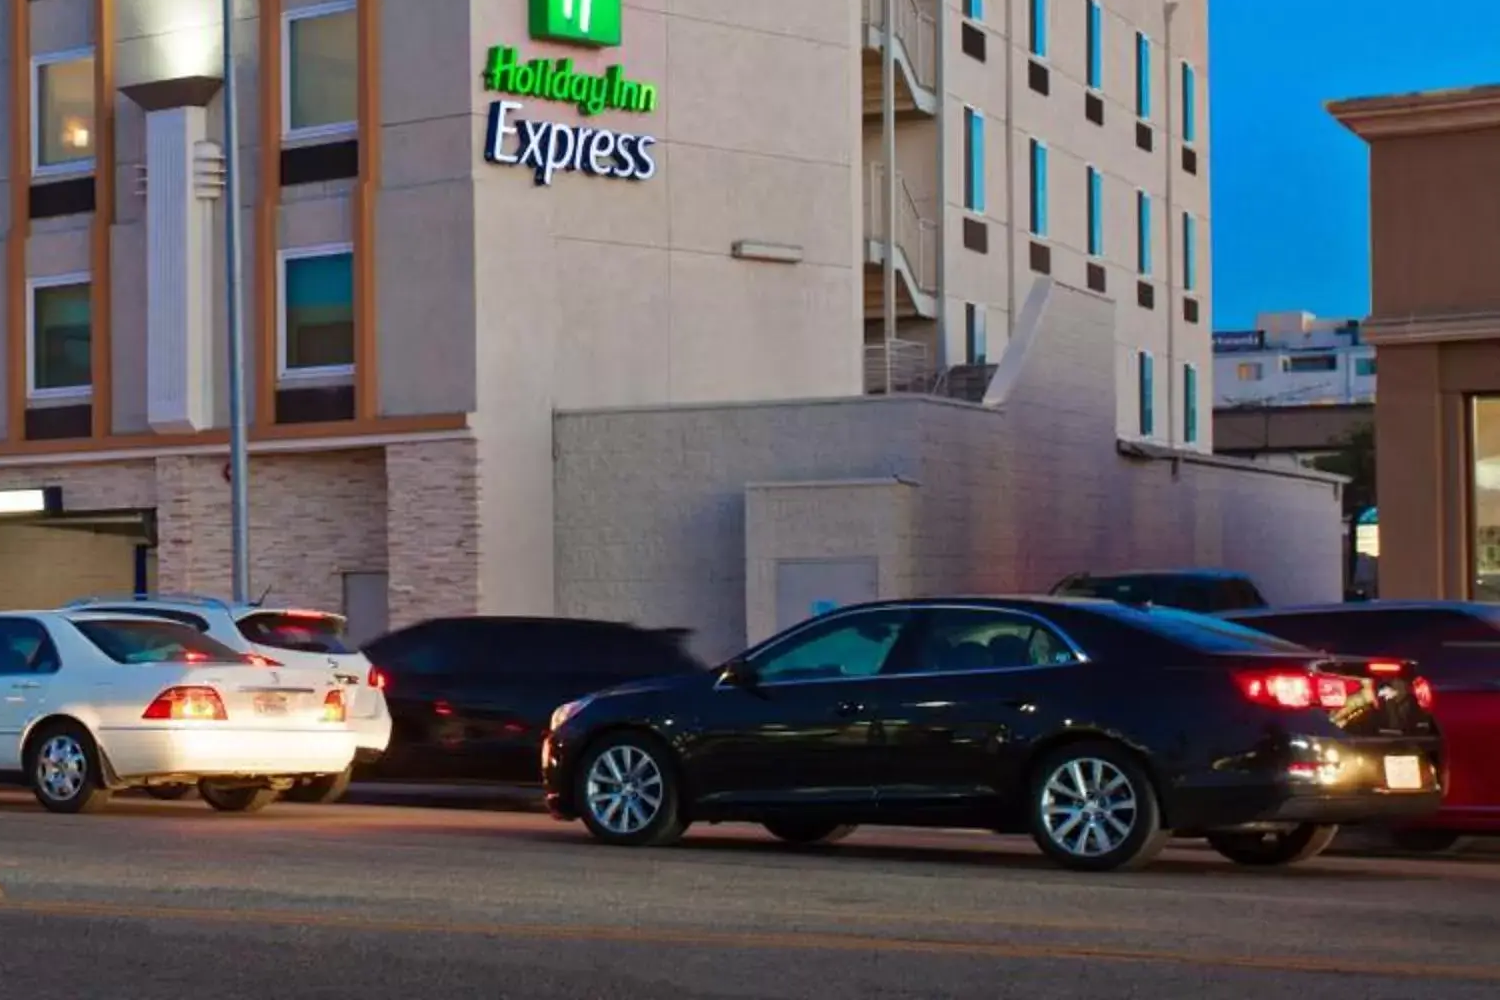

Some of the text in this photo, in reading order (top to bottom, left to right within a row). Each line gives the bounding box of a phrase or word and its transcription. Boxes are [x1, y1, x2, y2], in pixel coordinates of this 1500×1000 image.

[485, 45, 657, 115] Holiday Inn
[485, 100, 657, 186] Express
